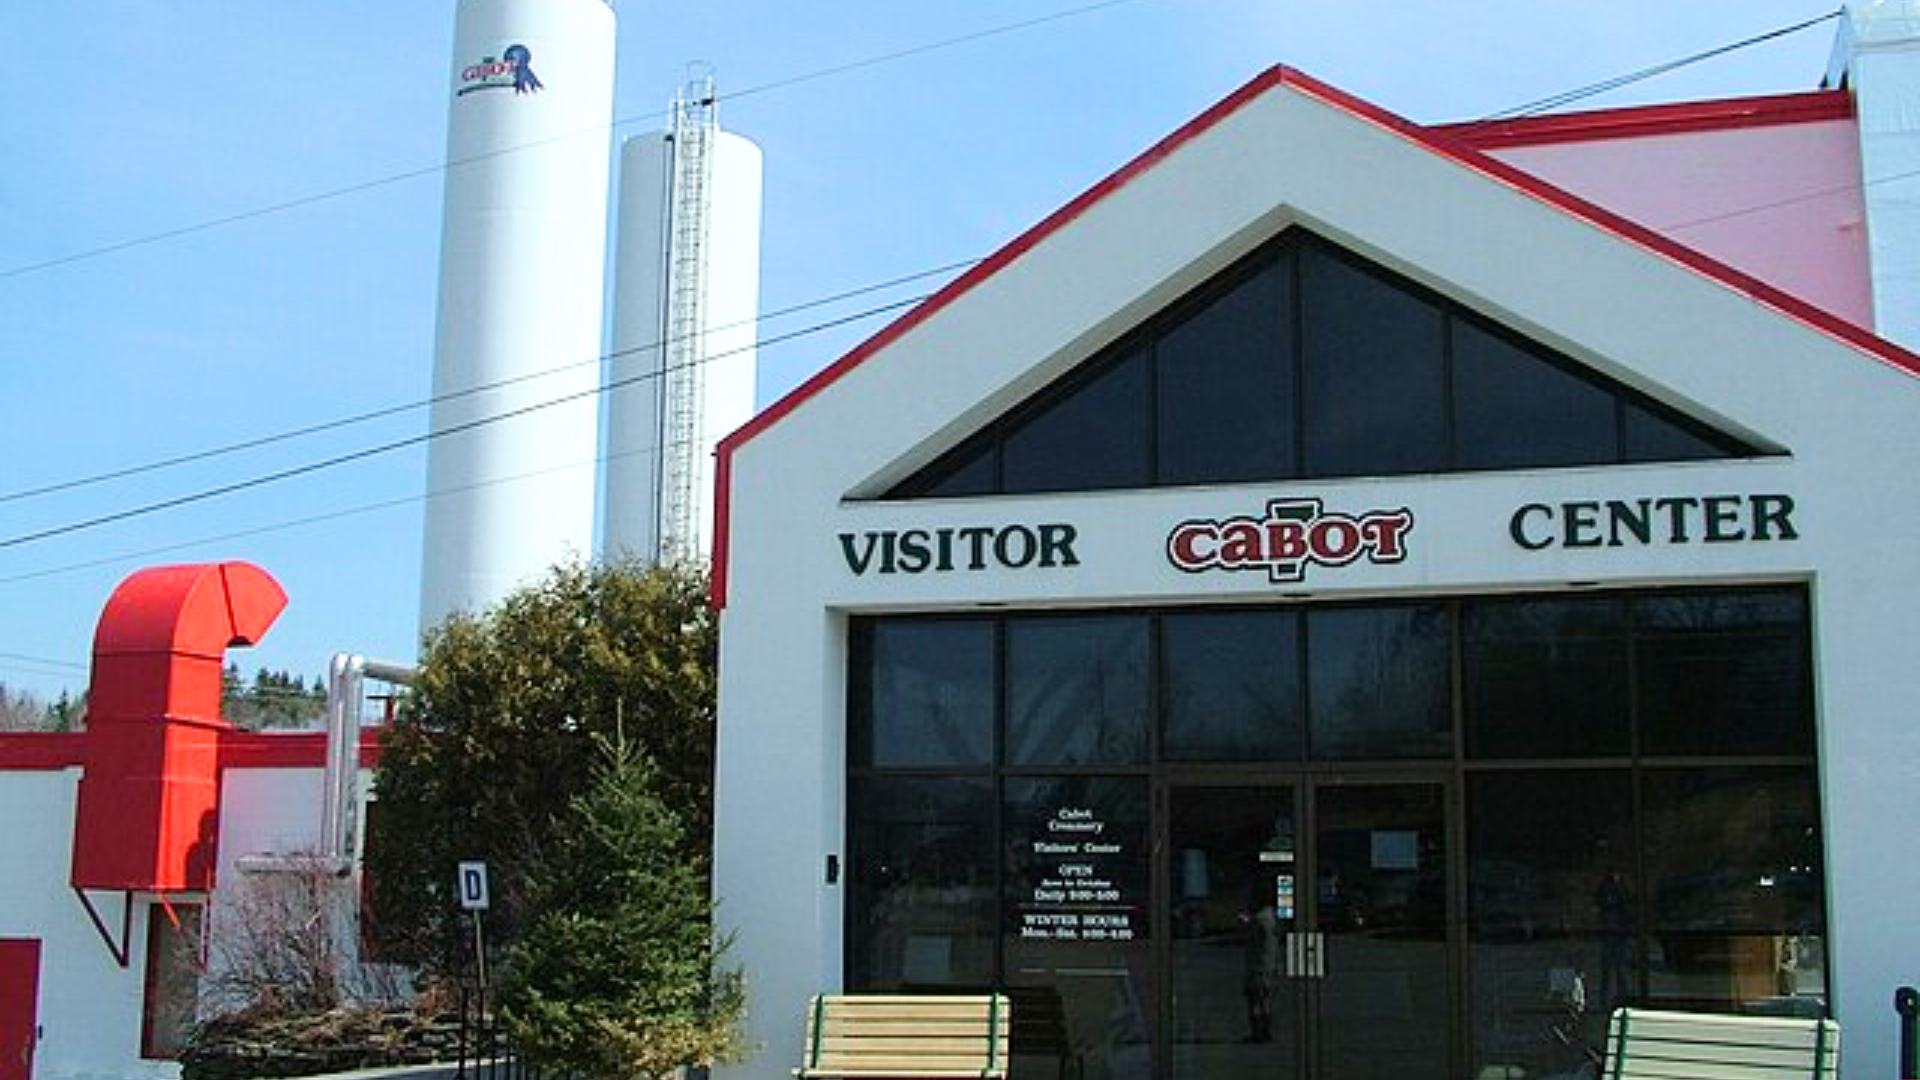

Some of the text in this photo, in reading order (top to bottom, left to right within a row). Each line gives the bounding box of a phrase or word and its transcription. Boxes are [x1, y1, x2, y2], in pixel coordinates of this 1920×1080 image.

[838, 524, 1081, 577] VISITOR
[1510, 494, 1799, 550] CENTER
[465, 869, 482, 900] D
[1058, 864, 1093, 877] OPEN
